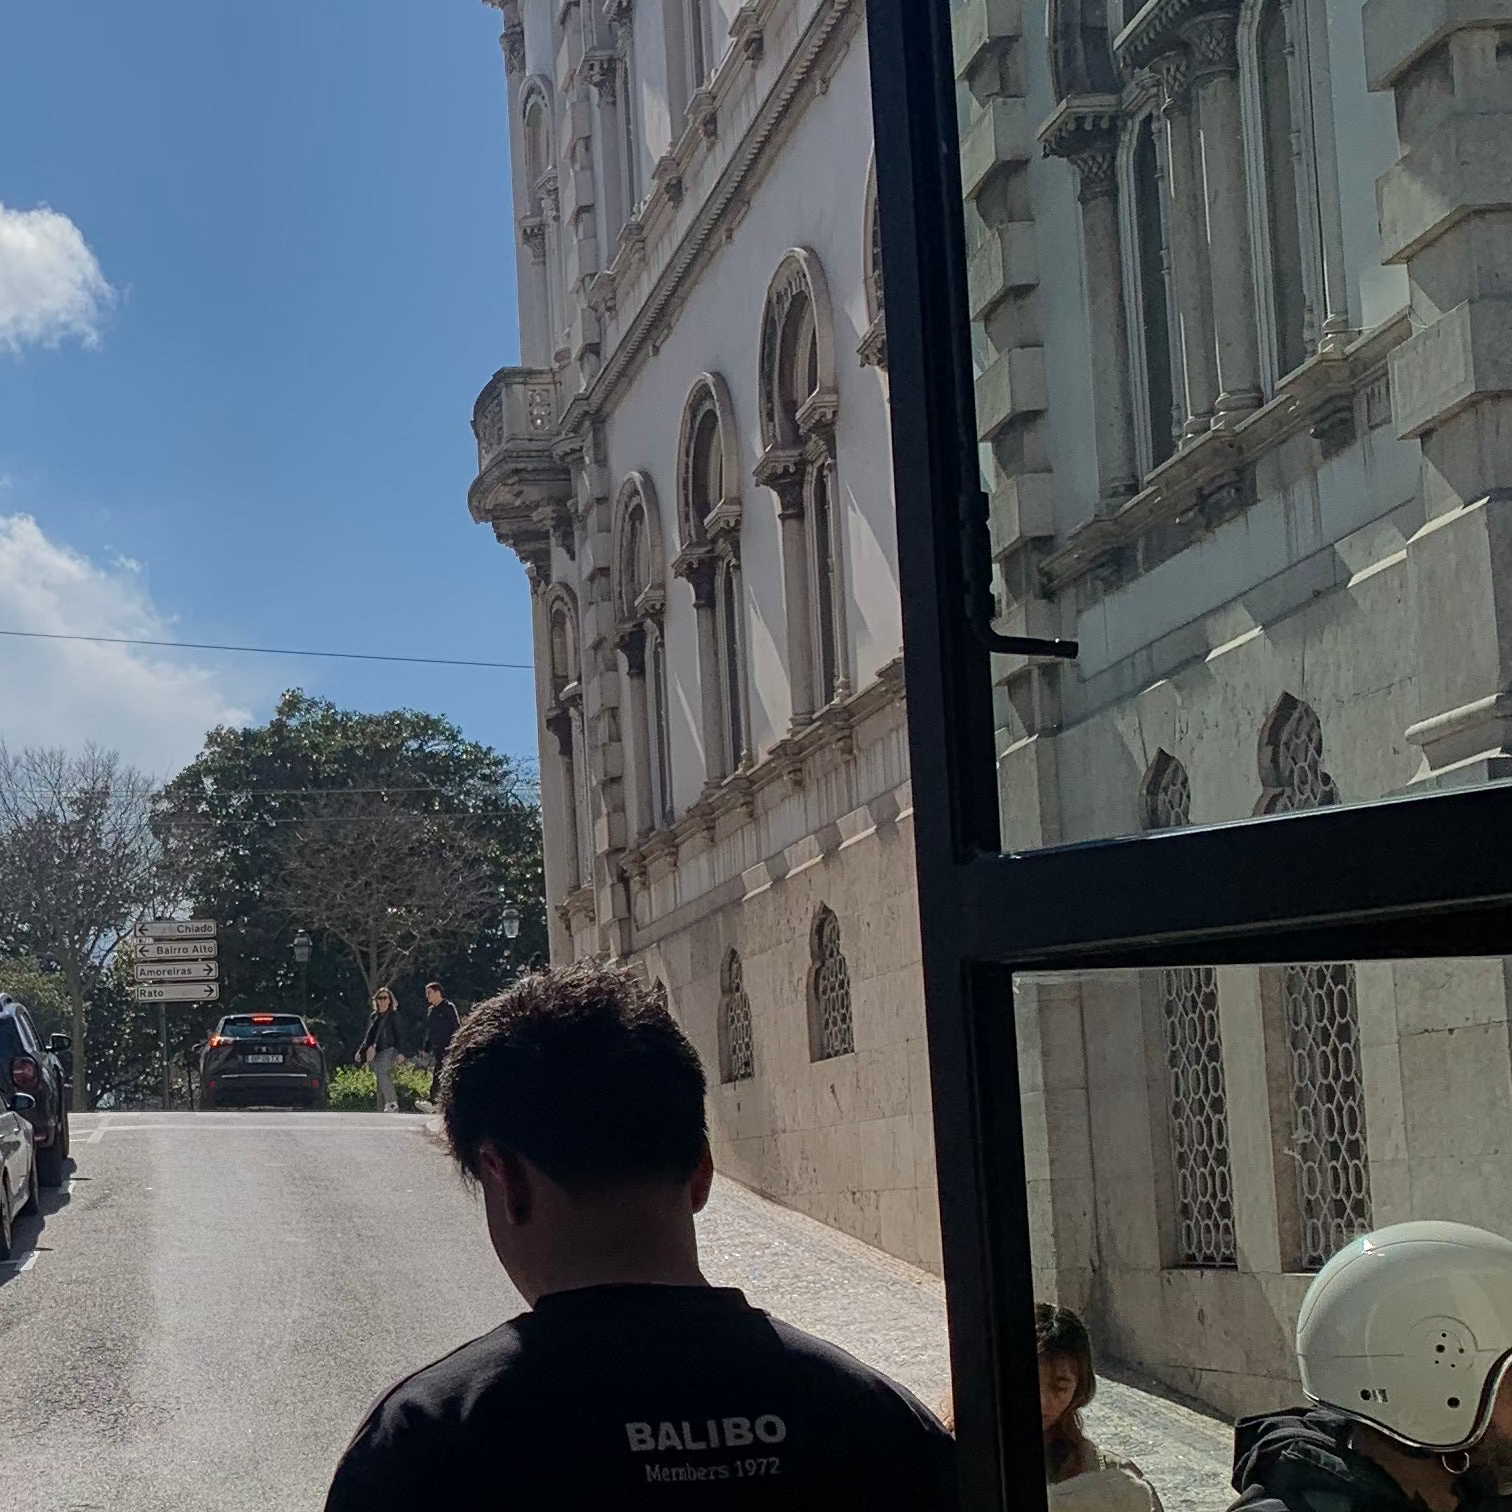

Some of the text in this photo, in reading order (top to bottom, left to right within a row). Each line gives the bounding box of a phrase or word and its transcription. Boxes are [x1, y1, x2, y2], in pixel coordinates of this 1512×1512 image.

[177, 924, 213, 934] Chiado
[156, 945, 214, 955] Bairro Alto
[139, 967, 192, 976] Amoreiras
[139, 989, 164, 998] Rato
[625, 1414, 787, 1451] BALIBO
[645, 1457, 781, 1482] Members 1972
